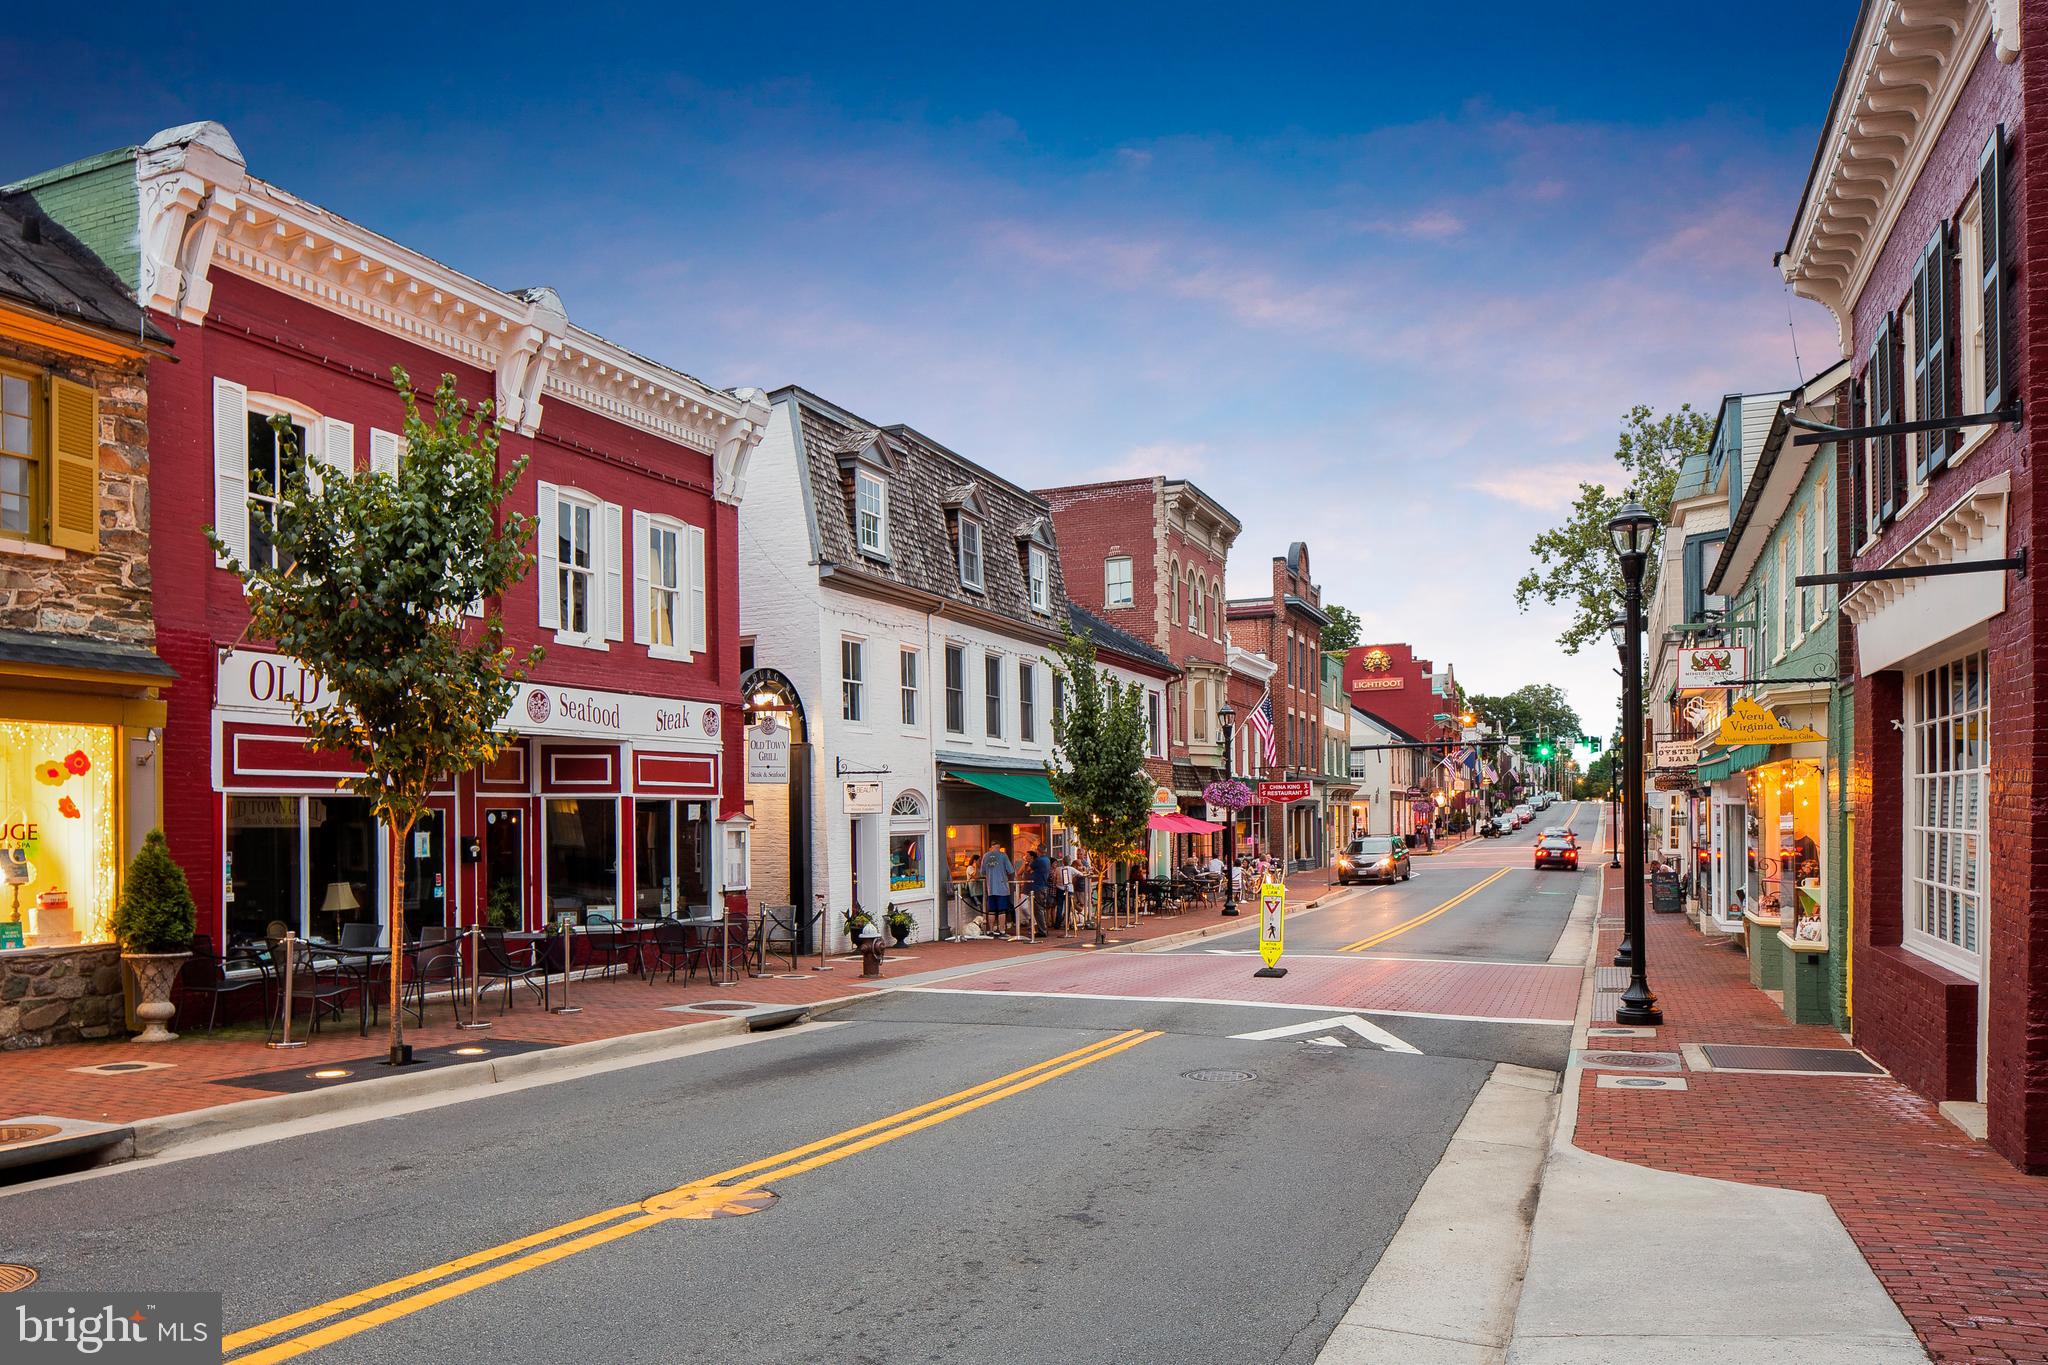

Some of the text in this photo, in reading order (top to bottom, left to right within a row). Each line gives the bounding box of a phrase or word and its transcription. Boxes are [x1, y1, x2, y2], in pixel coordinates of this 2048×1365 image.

[249, 660, 320, 704] OLD
[1354, 680, 1402, 689] LIGHTFOOT
[559, 692, 690, 732] Seafood Steak
[1738, 710, 1765, 722] Very
[1730, 720, 1774, 733] Virginia
[1798, 731, 1814, 740] Gifts
[750, 740, 786, 750] OLD TOWN
[758, 751, 779, 761] GRILL
[1658, 748, 1699, 757] OYSTER
